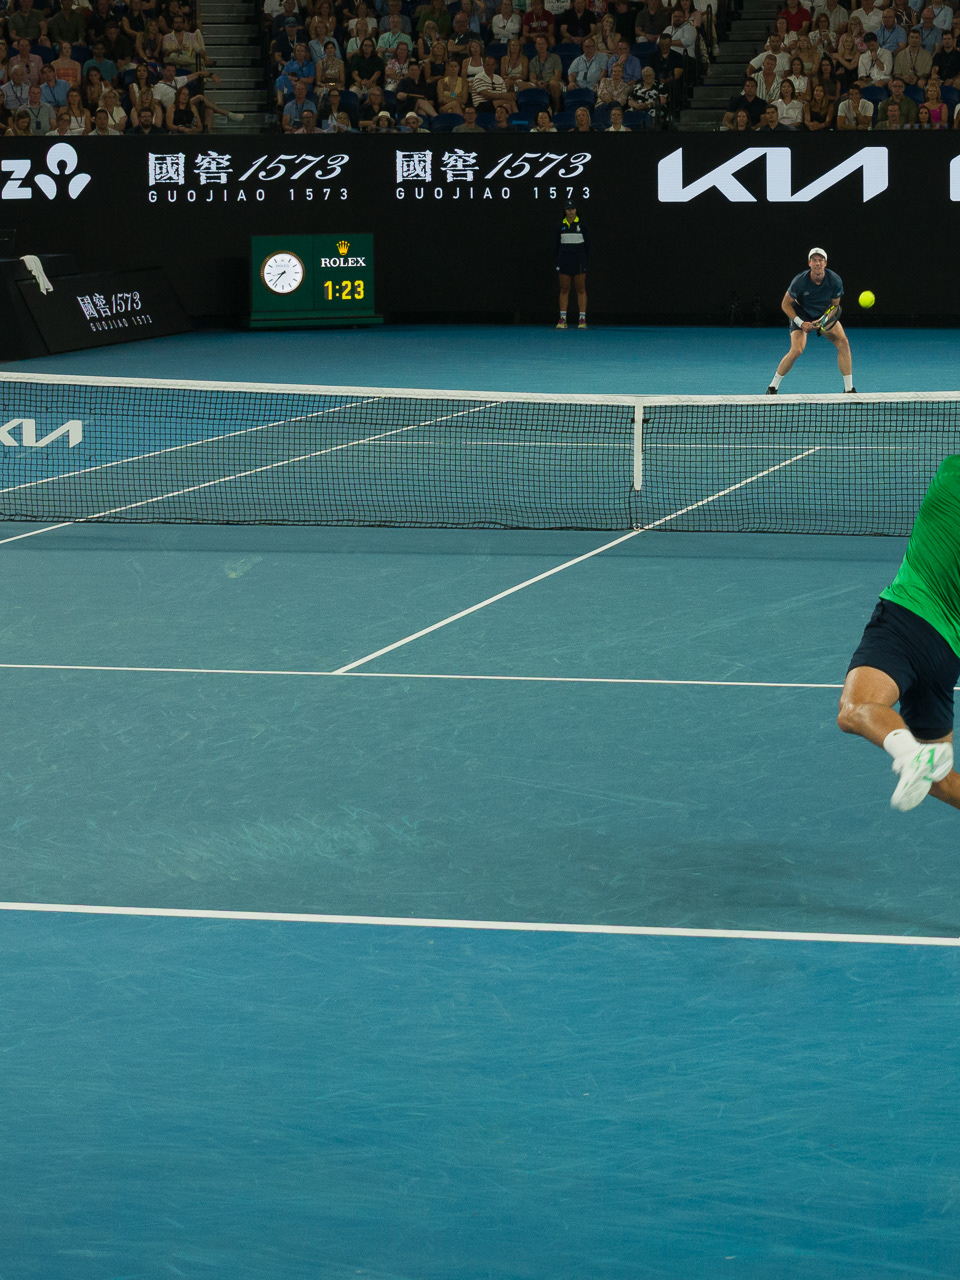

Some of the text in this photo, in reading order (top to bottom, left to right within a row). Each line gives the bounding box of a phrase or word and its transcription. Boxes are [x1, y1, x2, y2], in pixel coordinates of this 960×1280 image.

[657, 146, 889, 203] KIA
[148, 188, 348, 203] GUOJIAO 1573
[395, 186, 590, 200] GUOJIAO 1573
[320, 257, 366, 267] ROLEX
[323, 280, 365, 300] 1:23
[90, 314, 153, 332] GUOJIAO 1573
